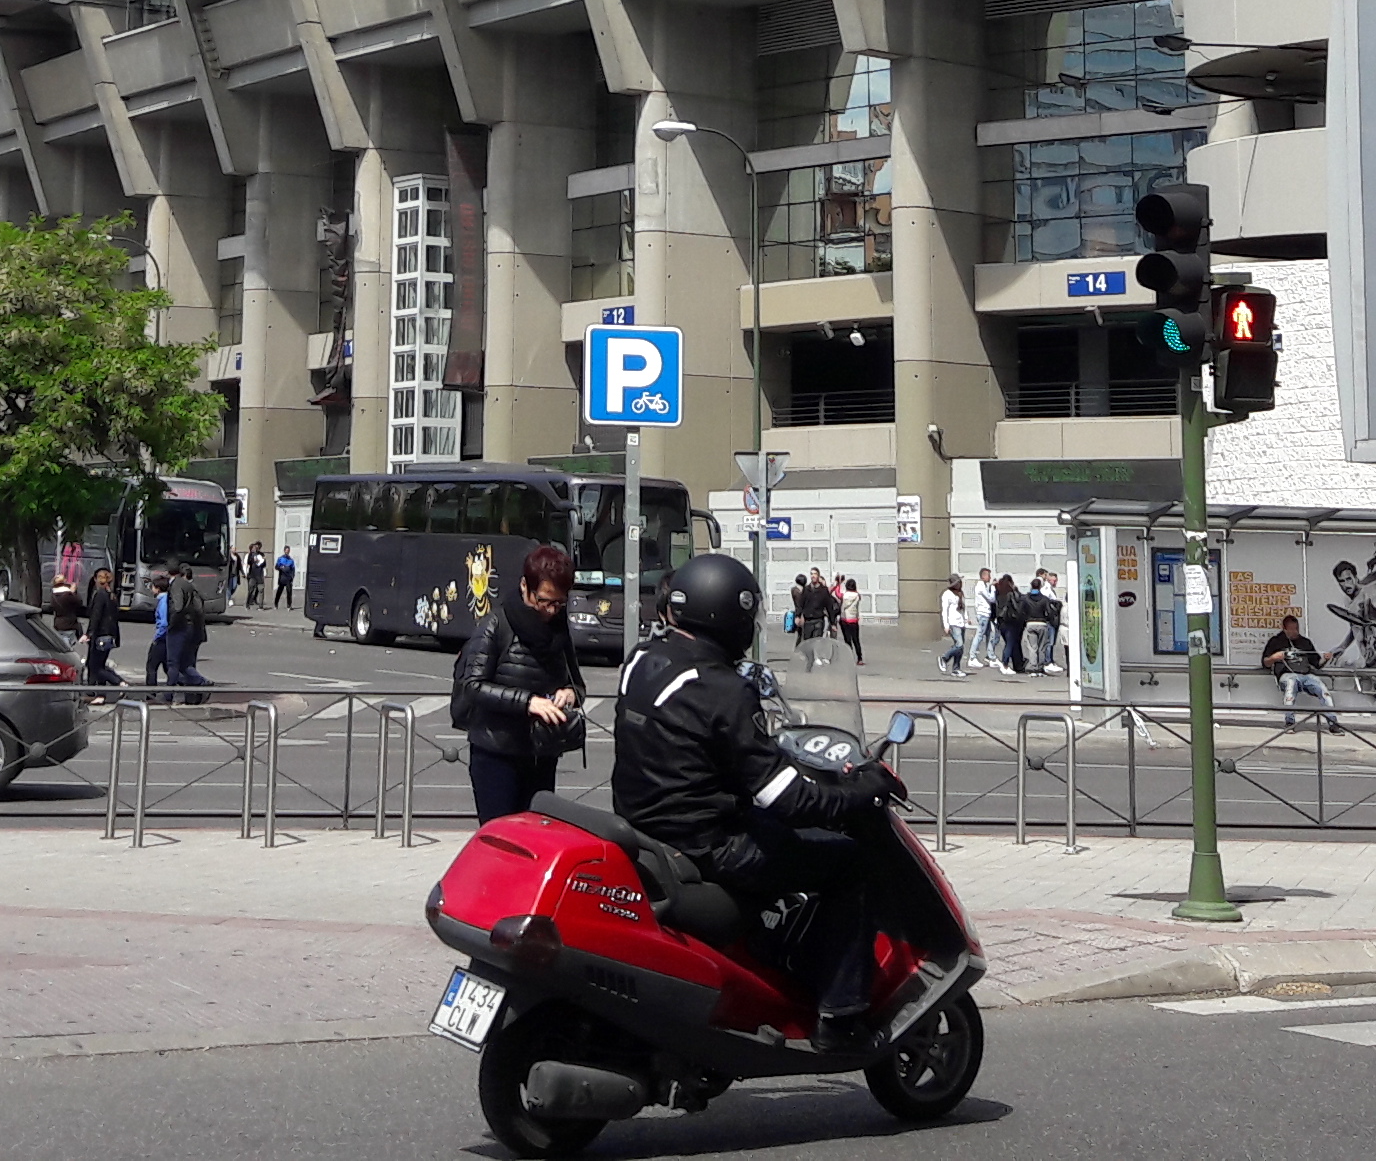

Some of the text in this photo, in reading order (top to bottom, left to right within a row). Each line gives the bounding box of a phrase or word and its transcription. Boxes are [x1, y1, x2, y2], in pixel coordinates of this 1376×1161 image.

[1085, 273, 1107, 293] 14
[612, 308, 625, 324] 12
[606, 337, 663, 414] P
[1230, 572, 1253, 582] LAS
[1231, 583, 1296, 594] ESTRELLAS
[1248, 606, 1302, 617] ESPERAN
[1231, 617, 1282, 628] EN MADR
[459, 976, 501, 1012] 1434
[447, 1005, 482, 1036] CLW
